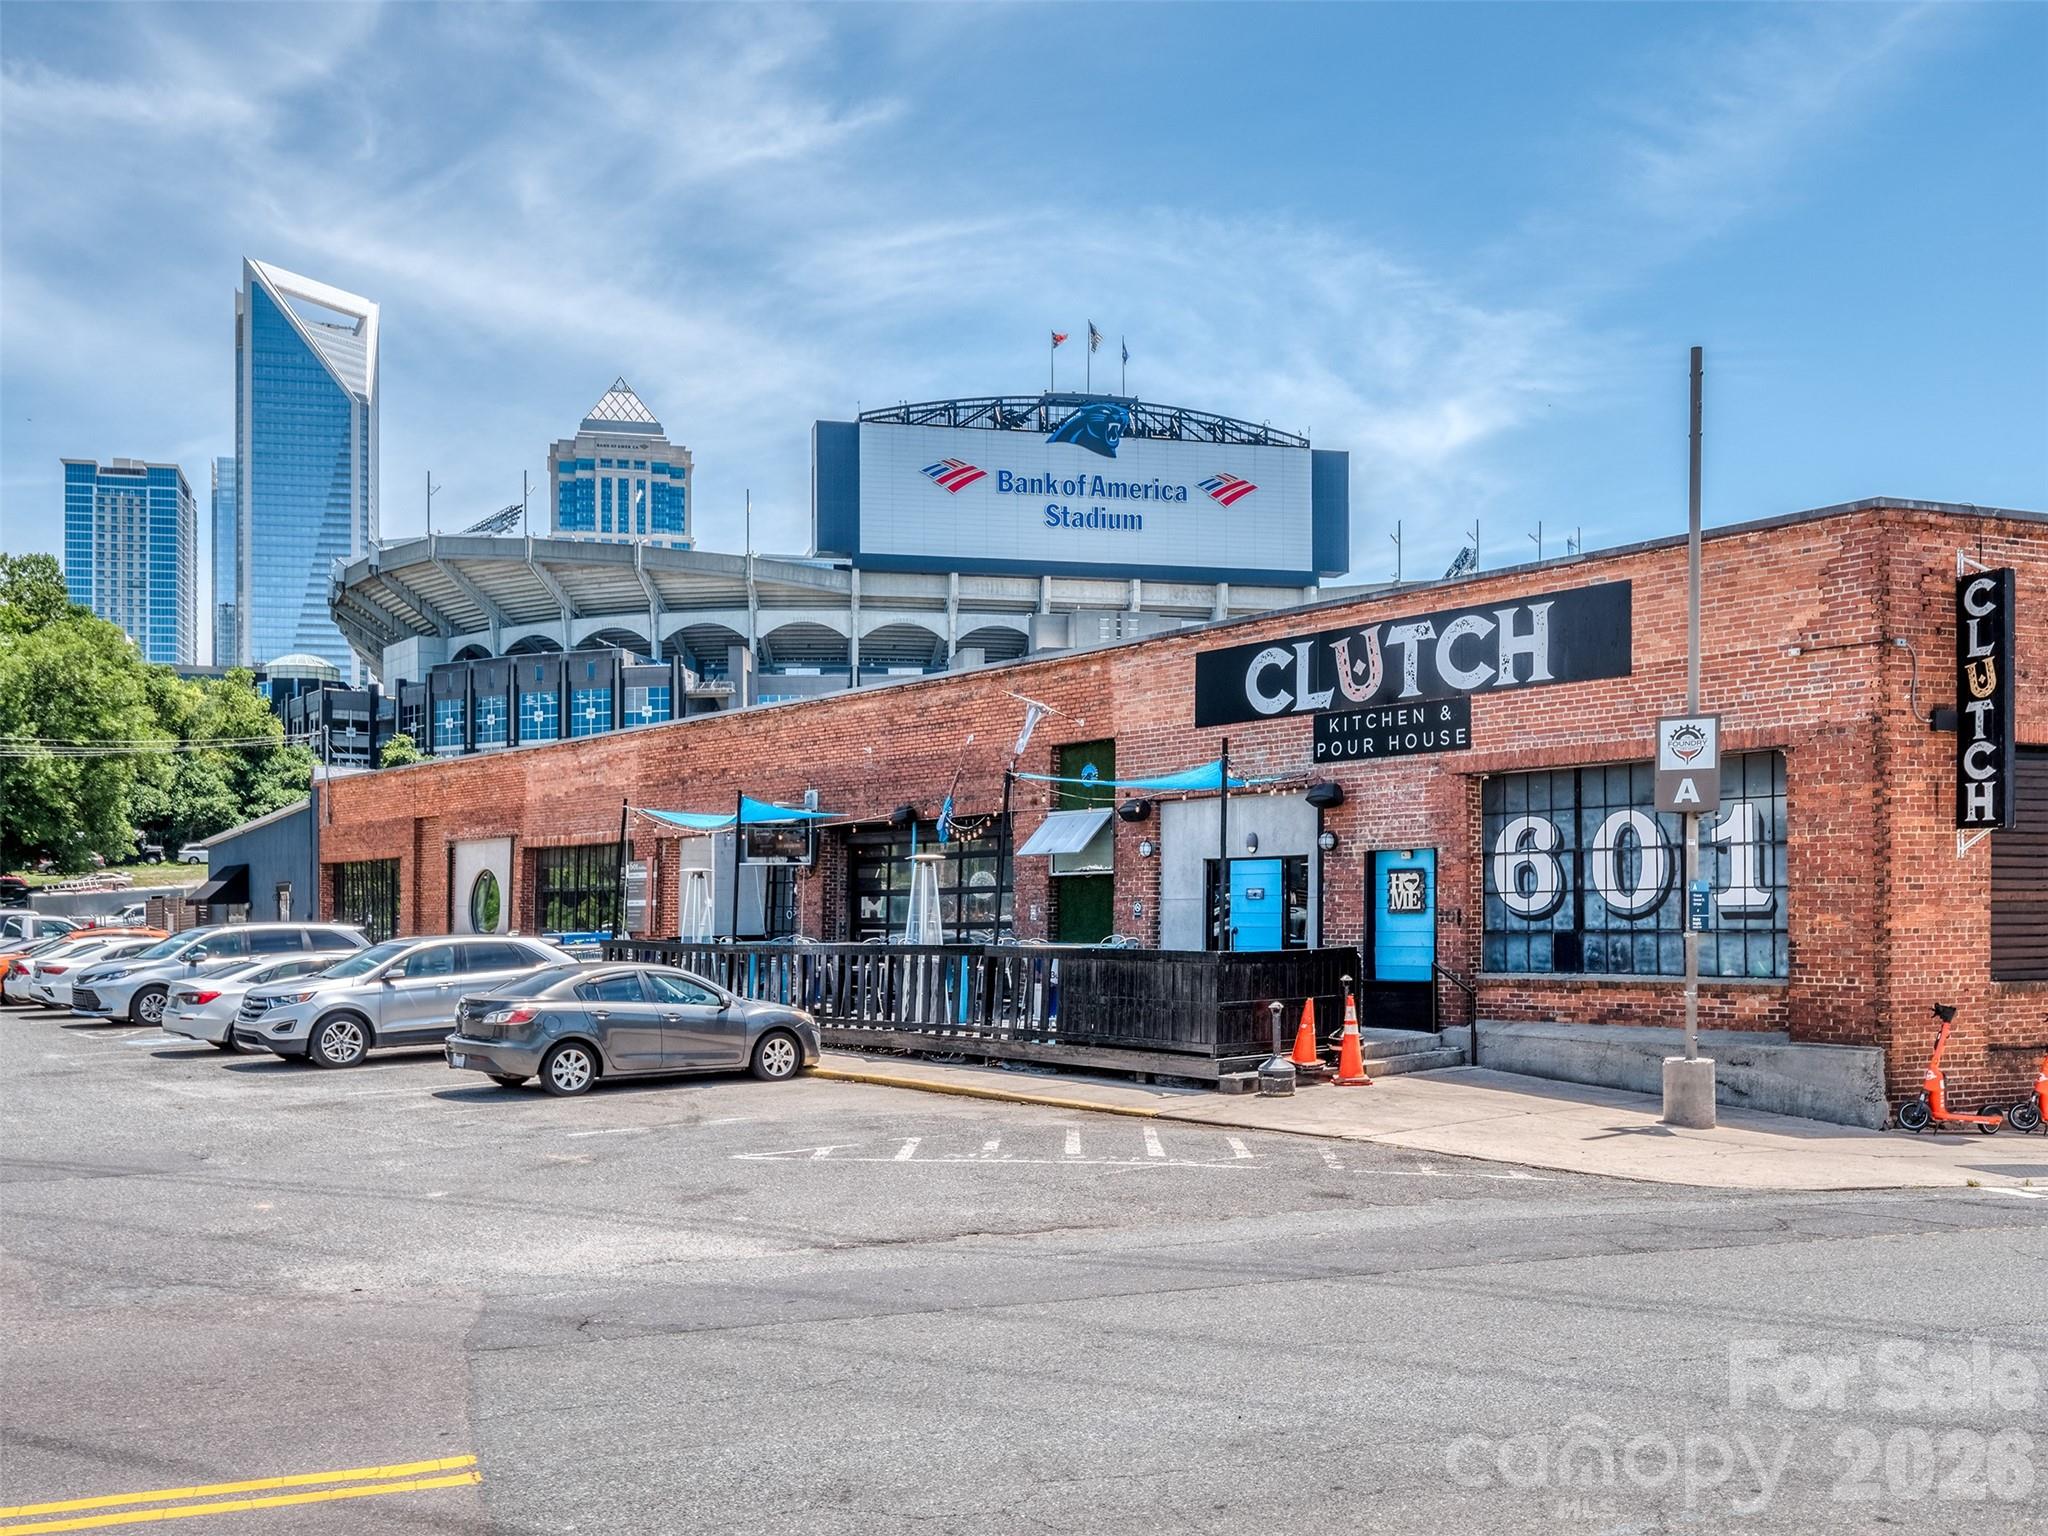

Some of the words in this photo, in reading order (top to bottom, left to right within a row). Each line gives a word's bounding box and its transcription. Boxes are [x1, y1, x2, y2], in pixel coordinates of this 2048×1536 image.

[998, 470, 1057, 494] Bank
[1062, 474, 1086, 496] of
[1090, 475, 1188, 502] America
[1045, 503, 1143, 530] Stadium
[1245, 601, 1556, 715] CLUTCH
[1963, 577, 1997, 823] CLUTCH
[1329, 707, 1425, 733] KITCHEN
[1440, 705, 1453, 721] &
[1317, 737, 1375, 758] POUR
[1388, 728, 1467, 749] HOUSE
[1668, 740, 1707, 748] FOUNDRY
[1673, 778, 1701, 803] A
[1494, 803, 1777, 920] 601
